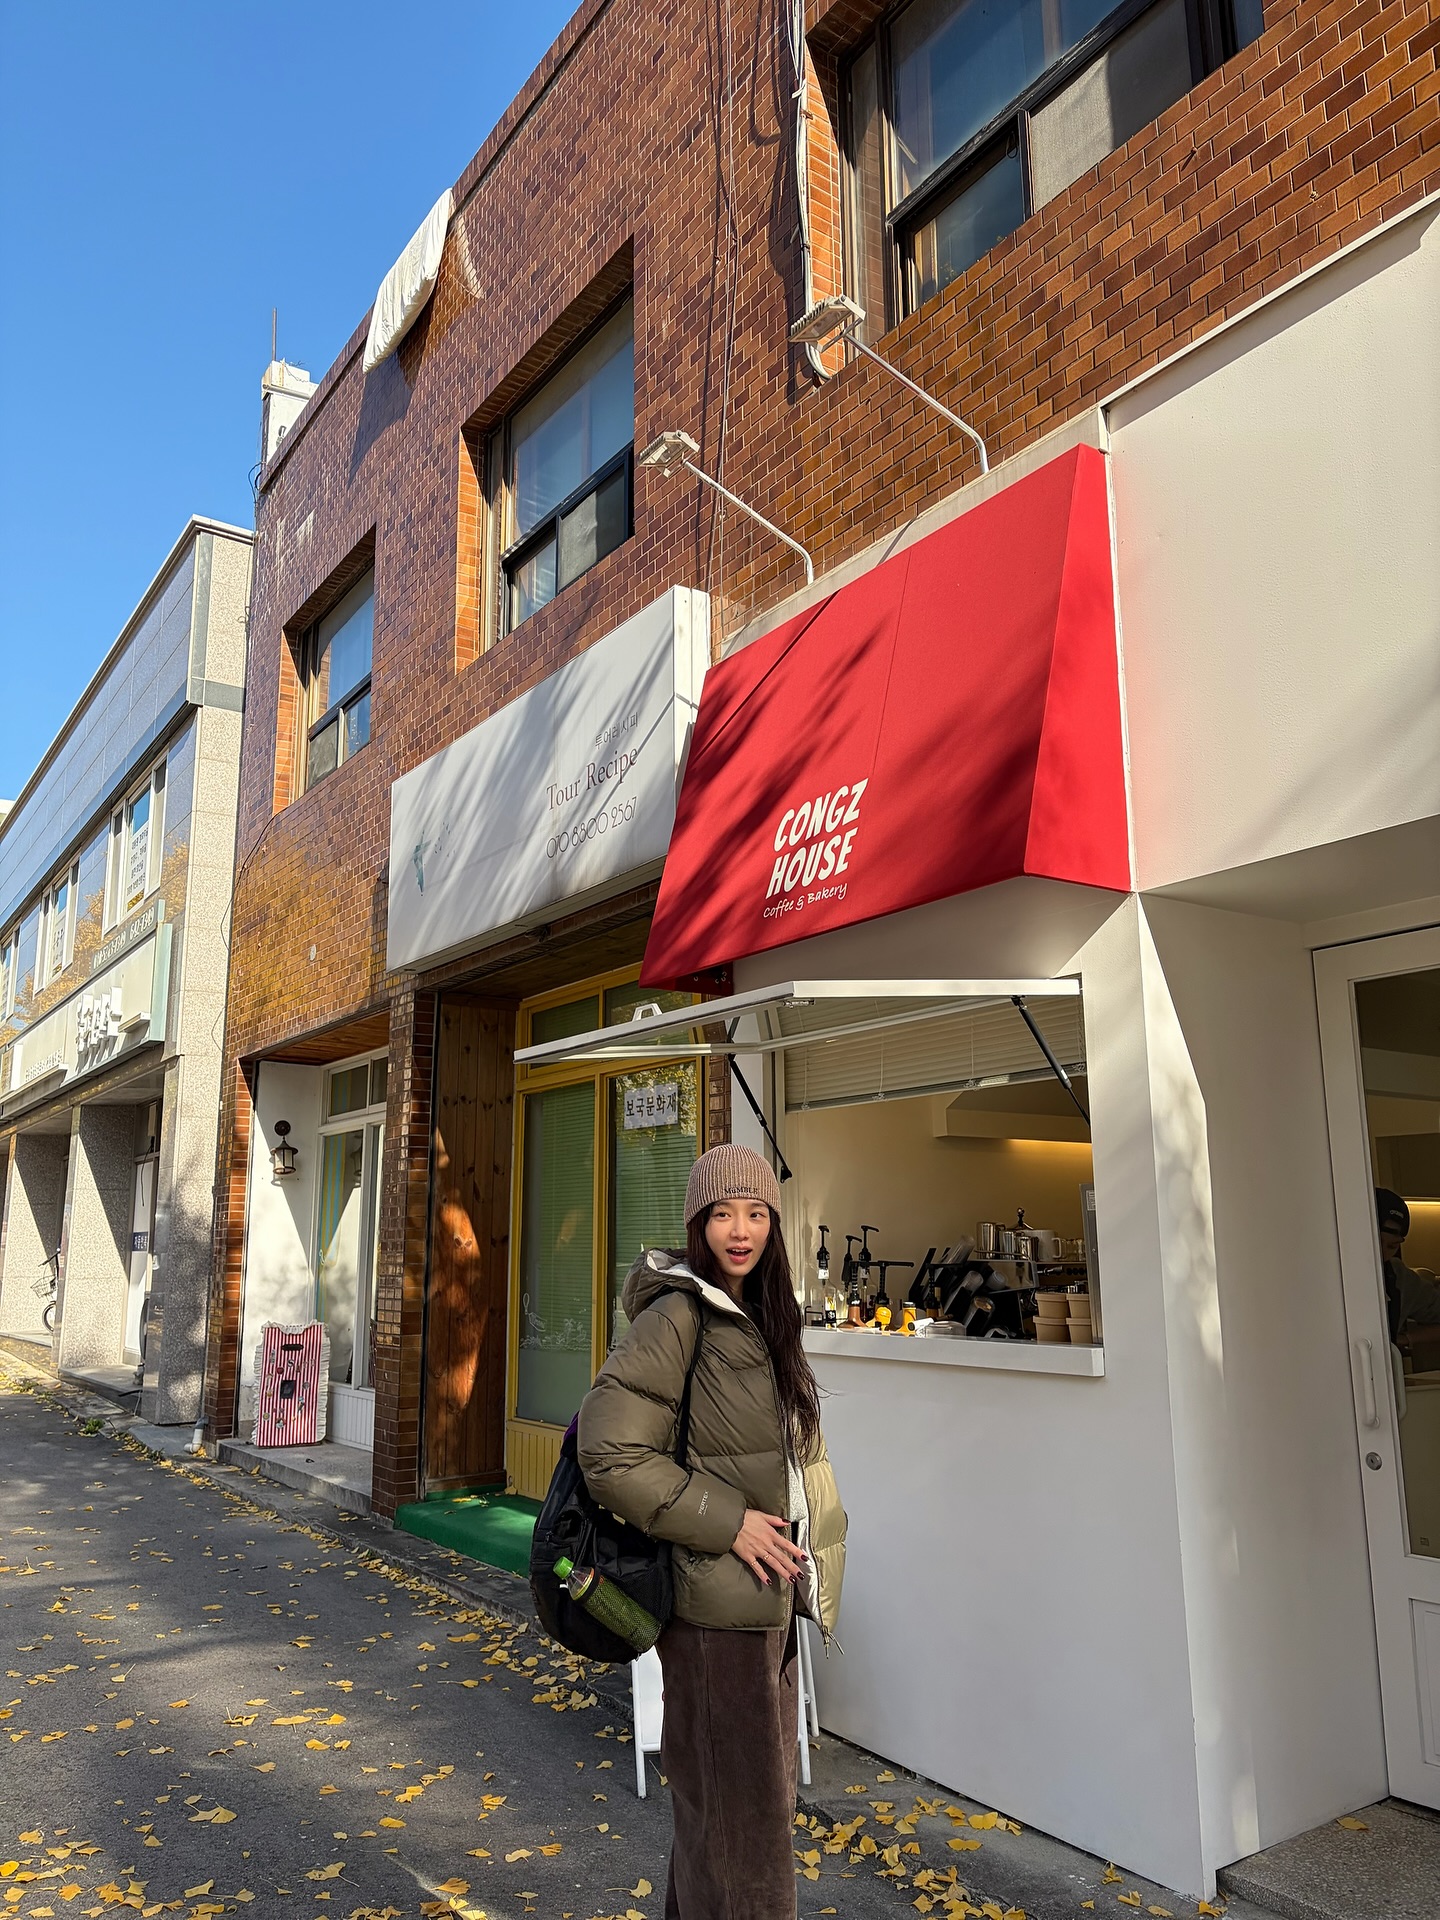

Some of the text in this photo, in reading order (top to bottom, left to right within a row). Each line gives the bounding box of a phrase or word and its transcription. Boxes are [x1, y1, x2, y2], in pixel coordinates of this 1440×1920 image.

[595, 712, 638, 749] 투어레시피
[547, 749, 638, 811] Tour Recipe
[546, 797, 638, 859] 070 8800 2567
[774, 778, 868, 851] CONGZ
[765, 827, 857, 898] HOUSE
[796, 896, 805, 911] &
[626, 1092, 677, 1118] 보국문화재
